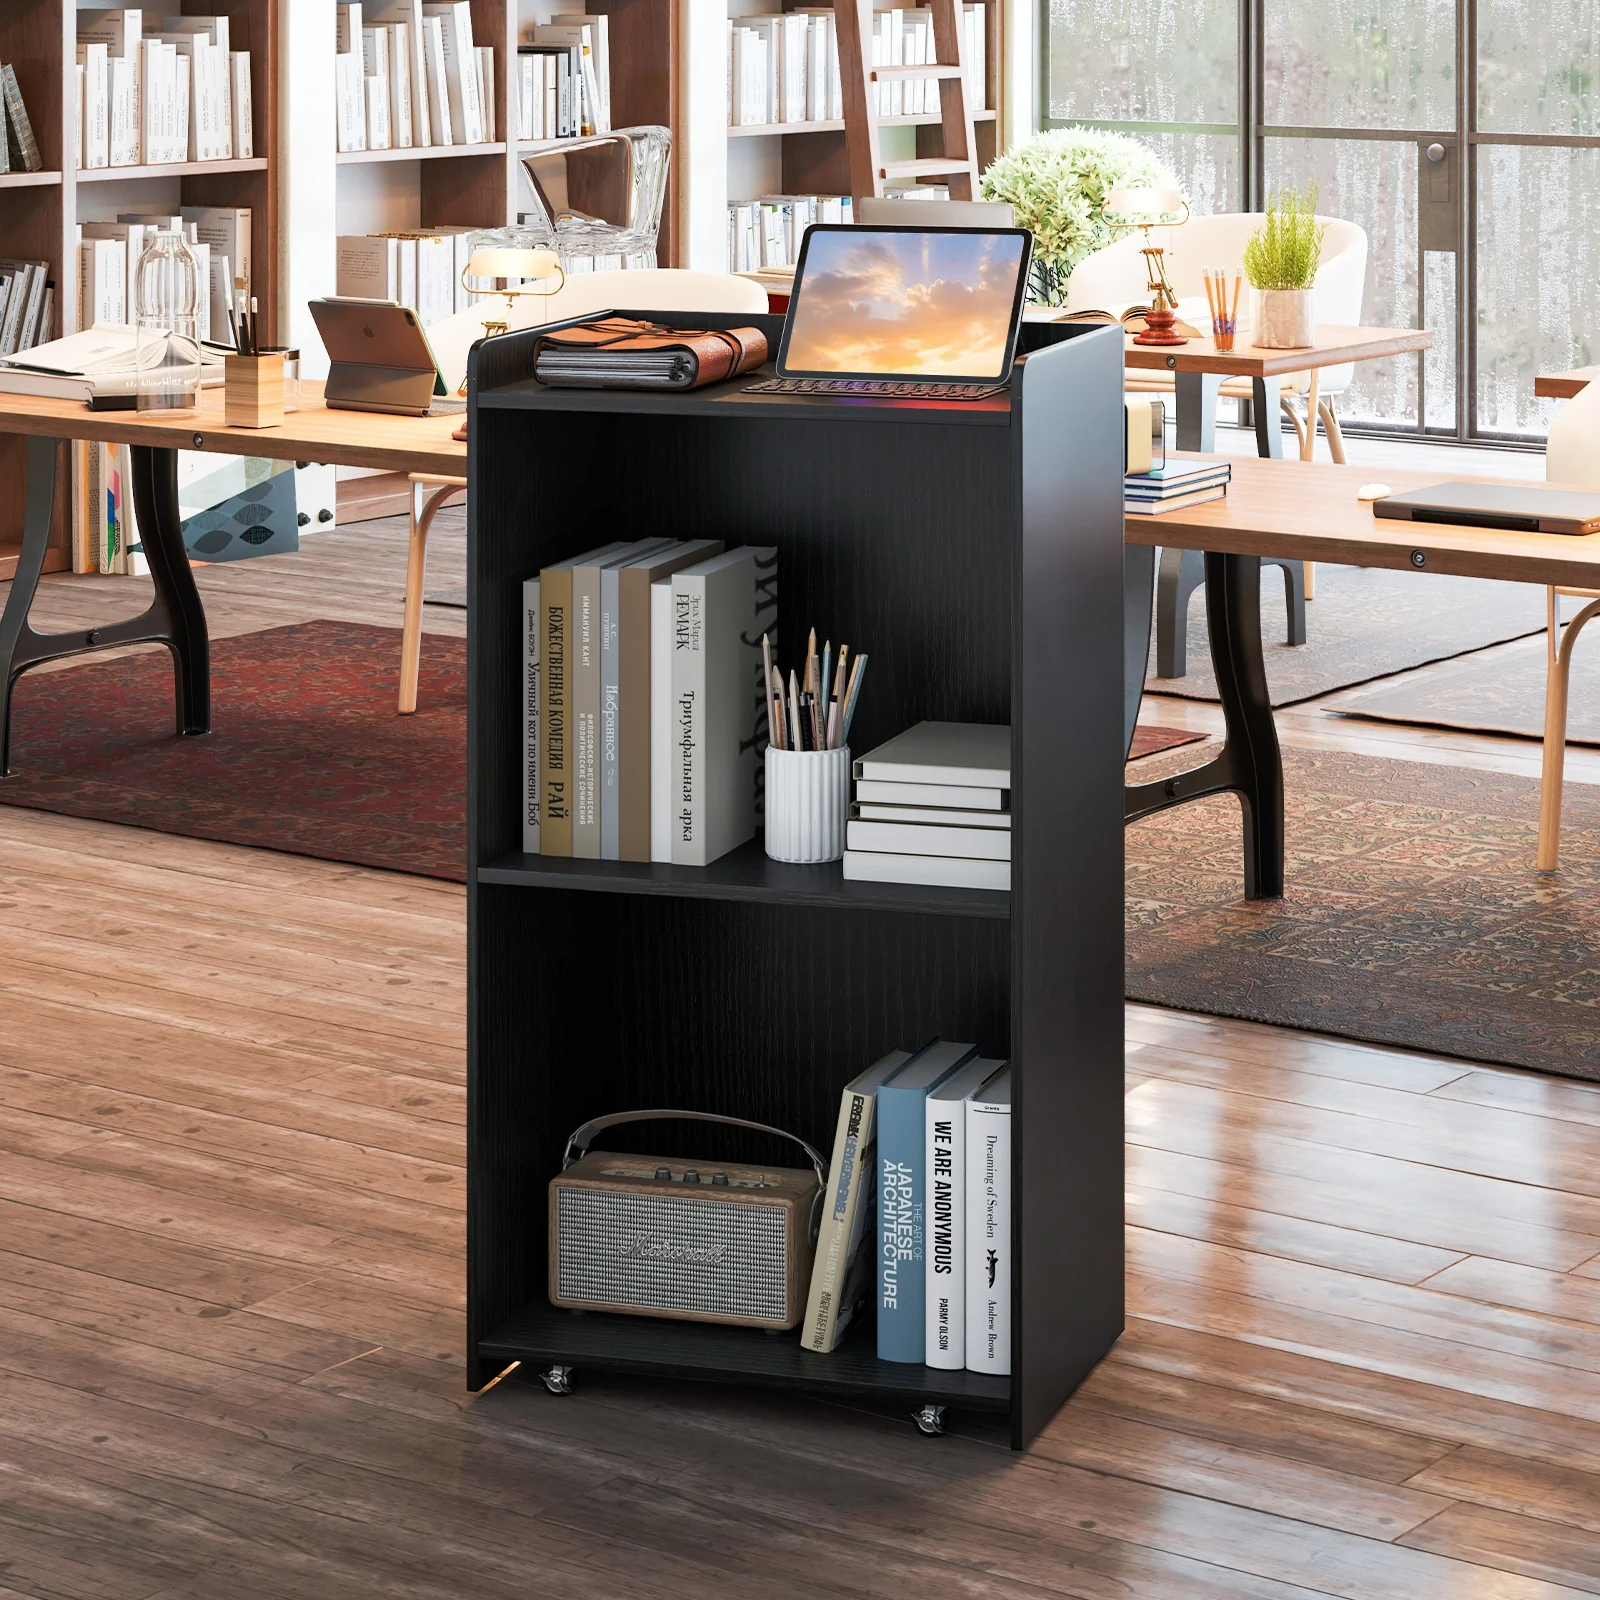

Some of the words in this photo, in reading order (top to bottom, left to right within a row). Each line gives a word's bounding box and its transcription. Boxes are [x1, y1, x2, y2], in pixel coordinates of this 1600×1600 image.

[582, 595, 590, 643] ИММАНУИЛ
[676, 593, 690, 651] РЕМАРК
[691, 594, 702, 618] Эрих
[691, 619, 702, 651] Мария
[548, 606, 564, 706] БОЖЕСТВЕННАЯ
[582, 645, 590, 667] КАНТ
[527, 662, 540, 716] Уличный
[528, 720, 536, 740] кот
[602, 684, 618, 762] Избранное
[528, 743, 535, 759] по
[546, 709, 564, 770] КОМЕДИЯ
[679, 690, 695, 803] Триумфальная
[527, 802, 540, 826] Боб
[548, 781, 569, 820] РАЙ
[679, 808, 693, 842] арка
[934, 1121, 952, 1144] WE
[934, 1147, 952, 1177] ARE
[983, 1135, 998, 1185] Dreaming
[985, 1186, 998, 1198] of
[897, 1162, 913, 1261] JAPANESE
[913, 1202, 923, 1223] THE
[934, 1180, 952, 1275] ANONYMOUS
[986, 1199, 998, 1238] Sweden
[619, 1231, 728, 1264] Marshall
[883, 1159, 897, 1310] ARCHITECTURE
[913, 1224, 923, 1246] ART
[913, 1247, 923, 1261] OF
[938, 1298, 949, 1324] PARMY
[988, 1299, 998, 1331] Andrew
[938, 1325, 949, 1350] OLSON
[988, 1333, 998, 1359] Brown
